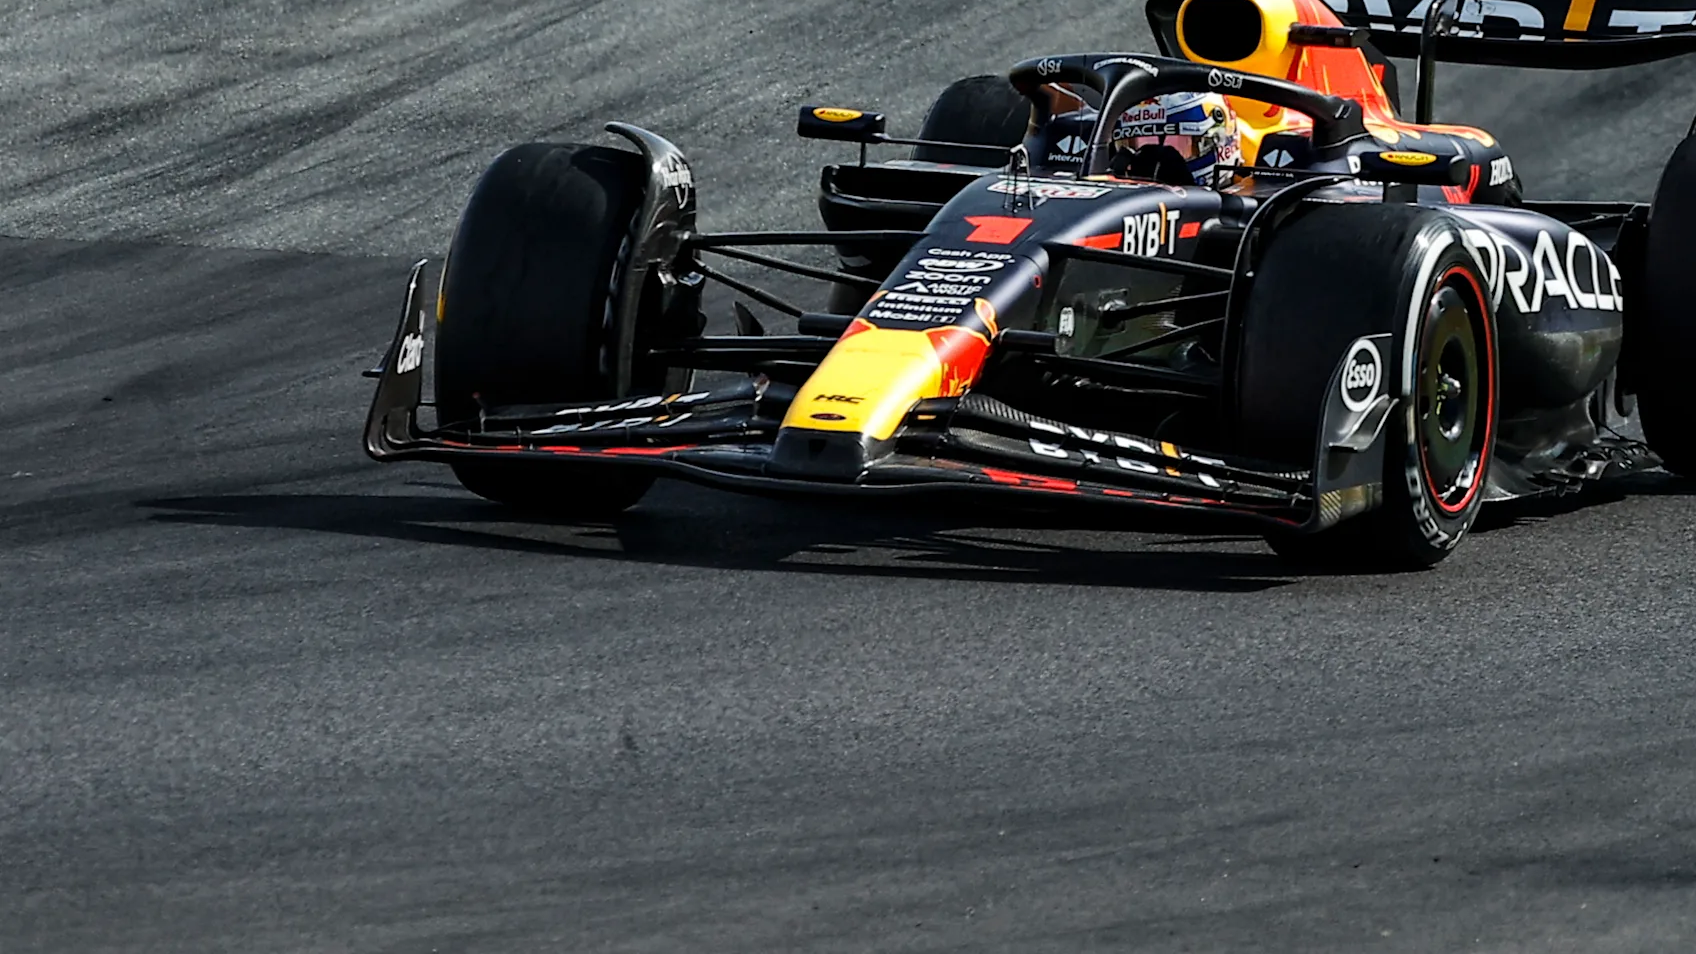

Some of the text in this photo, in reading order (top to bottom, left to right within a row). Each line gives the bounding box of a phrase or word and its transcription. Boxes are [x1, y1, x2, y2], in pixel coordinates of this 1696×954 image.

[1223, 74, 1243, 89] Sui
[1122, 108, 1165, 124] Red Bull
[1113, 122, 1176, 140] ORACLE
[964, 215, 1033, 244] 1
[1123, 202, 1180, 257] BYBIT
[928, 248, 971, 258] Cash
[905, 271, 991, 285] zoom
[928, 283, 982, 292] ARCTIC
[869, 309, 932, 323] Mobil
[1347, 358, 1375, 389] Esso
